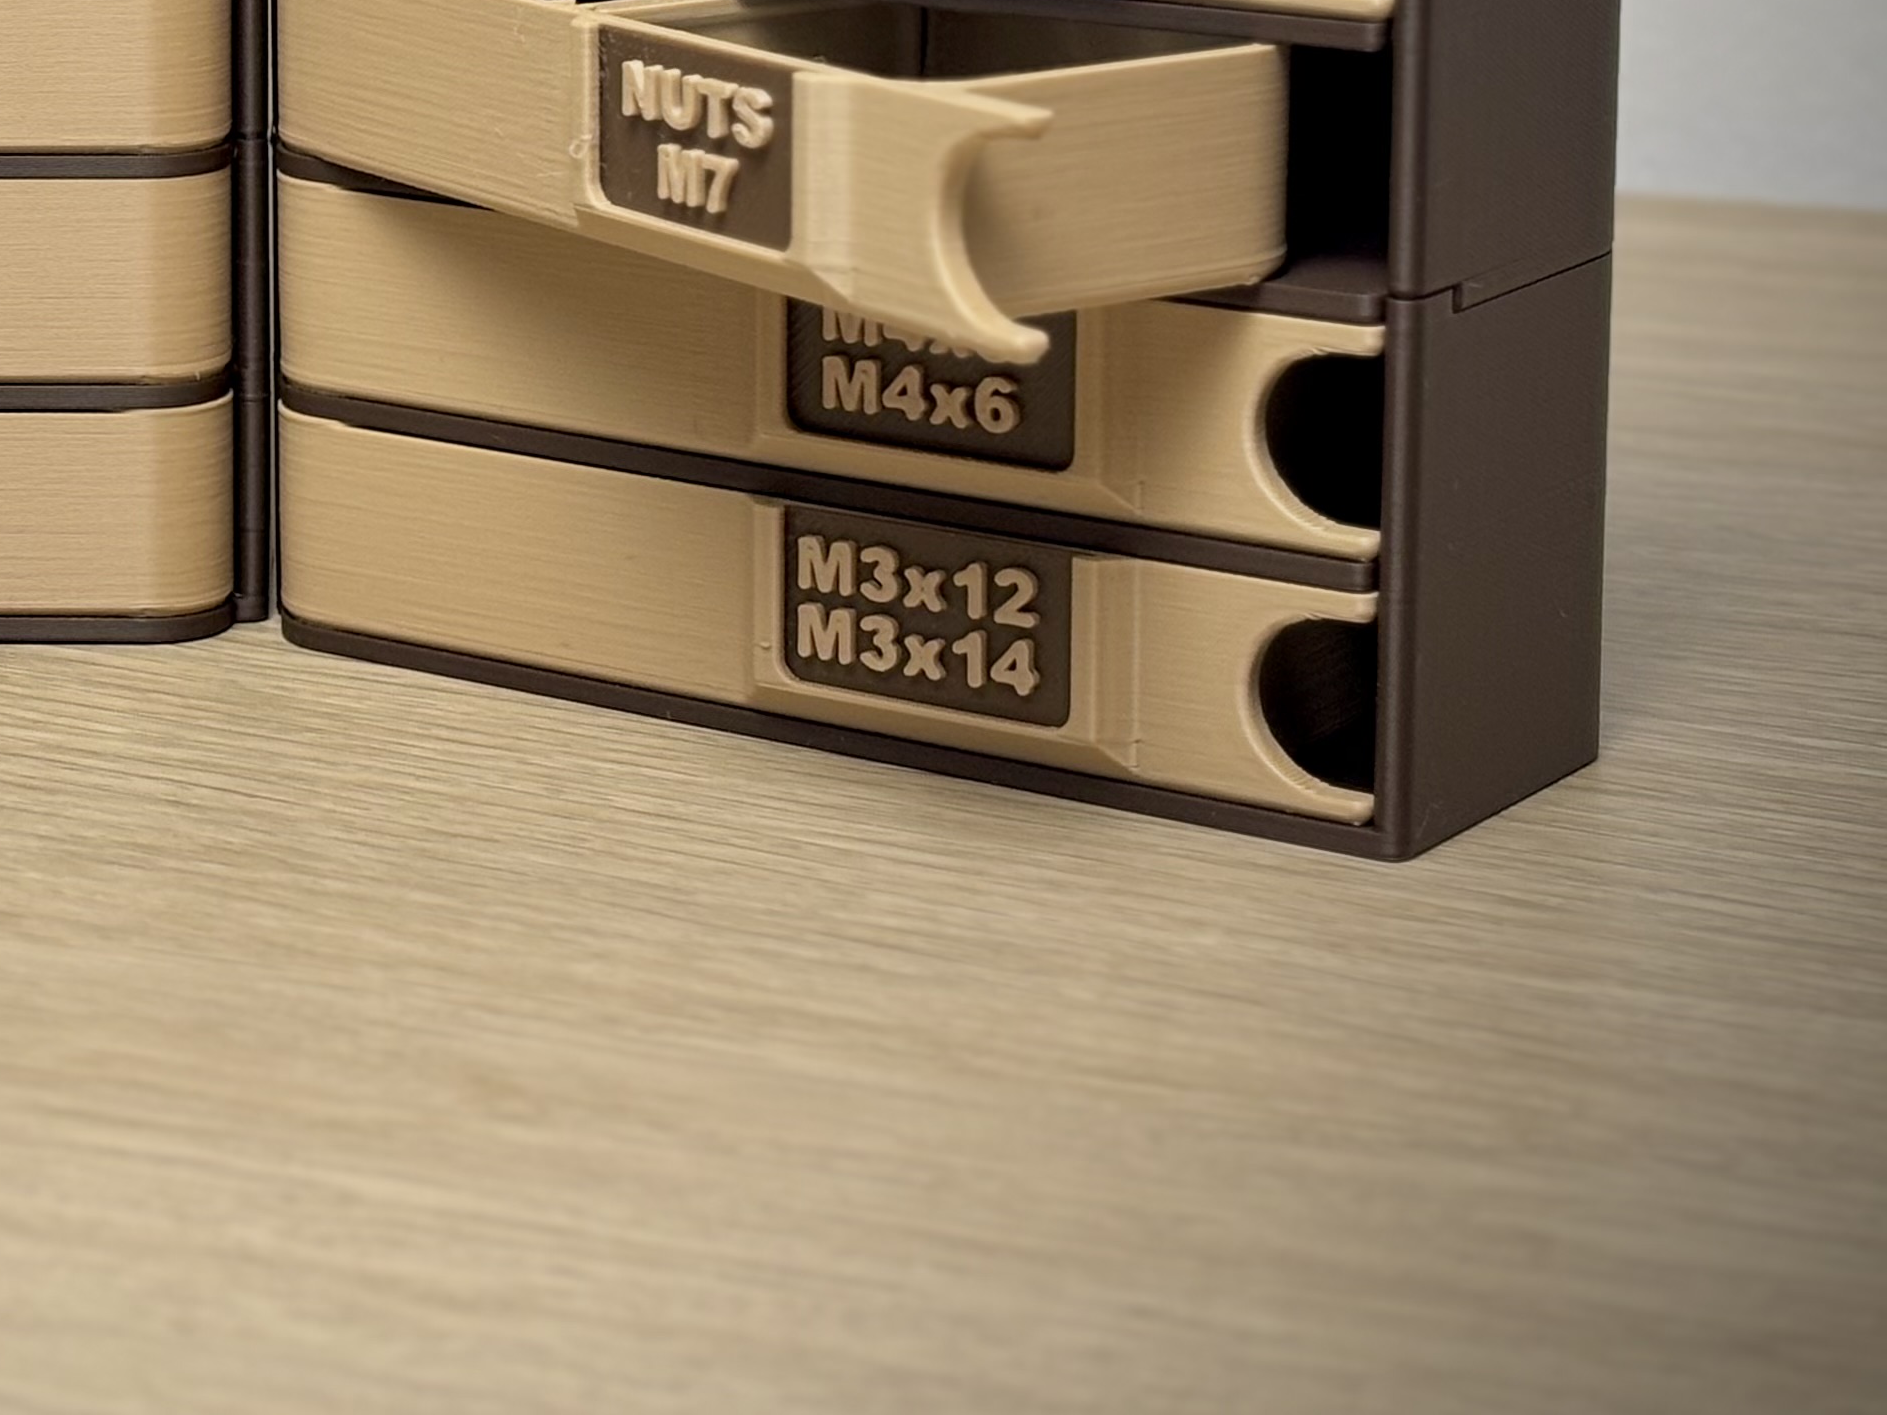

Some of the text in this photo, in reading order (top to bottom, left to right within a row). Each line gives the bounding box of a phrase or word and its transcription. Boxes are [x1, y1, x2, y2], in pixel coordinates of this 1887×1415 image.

[621, 59, 774, 148] NUTS
[657, 142, 739, 214] M7
[821, 355, 1020, 435] M4x6
[796, 535, 1040, 629] M3x12
[796, 602, 1040, 697] M3x14
